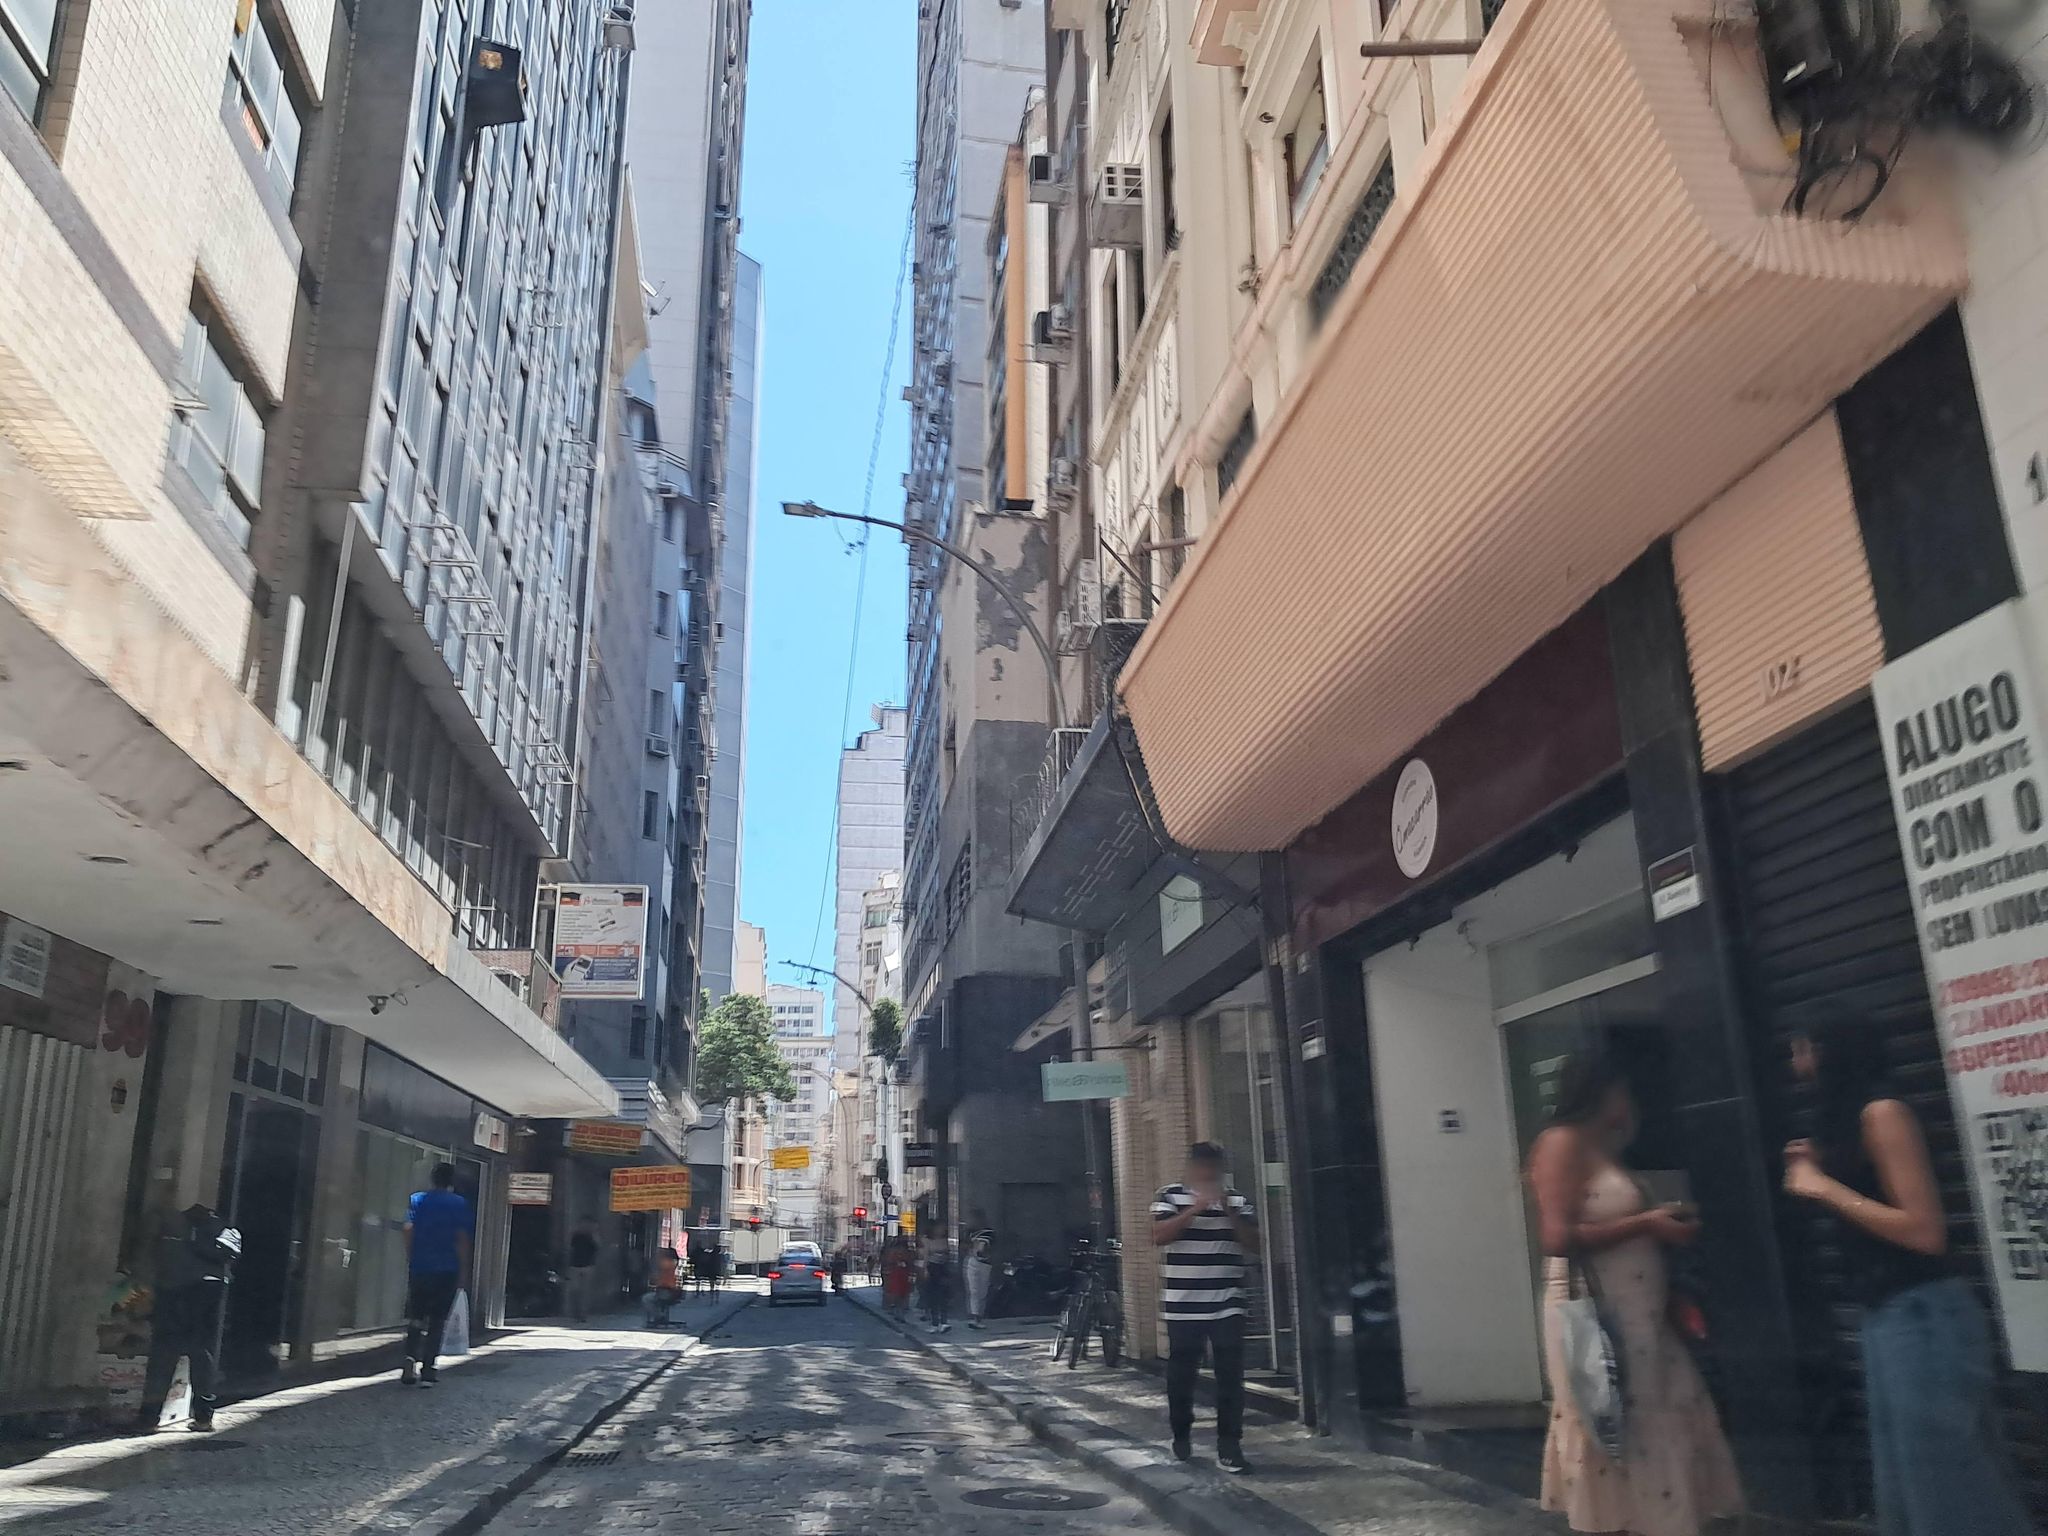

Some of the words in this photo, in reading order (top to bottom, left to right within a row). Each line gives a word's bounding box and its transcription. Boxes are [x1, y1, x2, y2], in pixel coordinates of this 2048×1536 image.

[1894, 671, 2020, 777] ALUGO
[1910, 795, 1992, 870] COM
[2012, 777, 2042, 834] O
